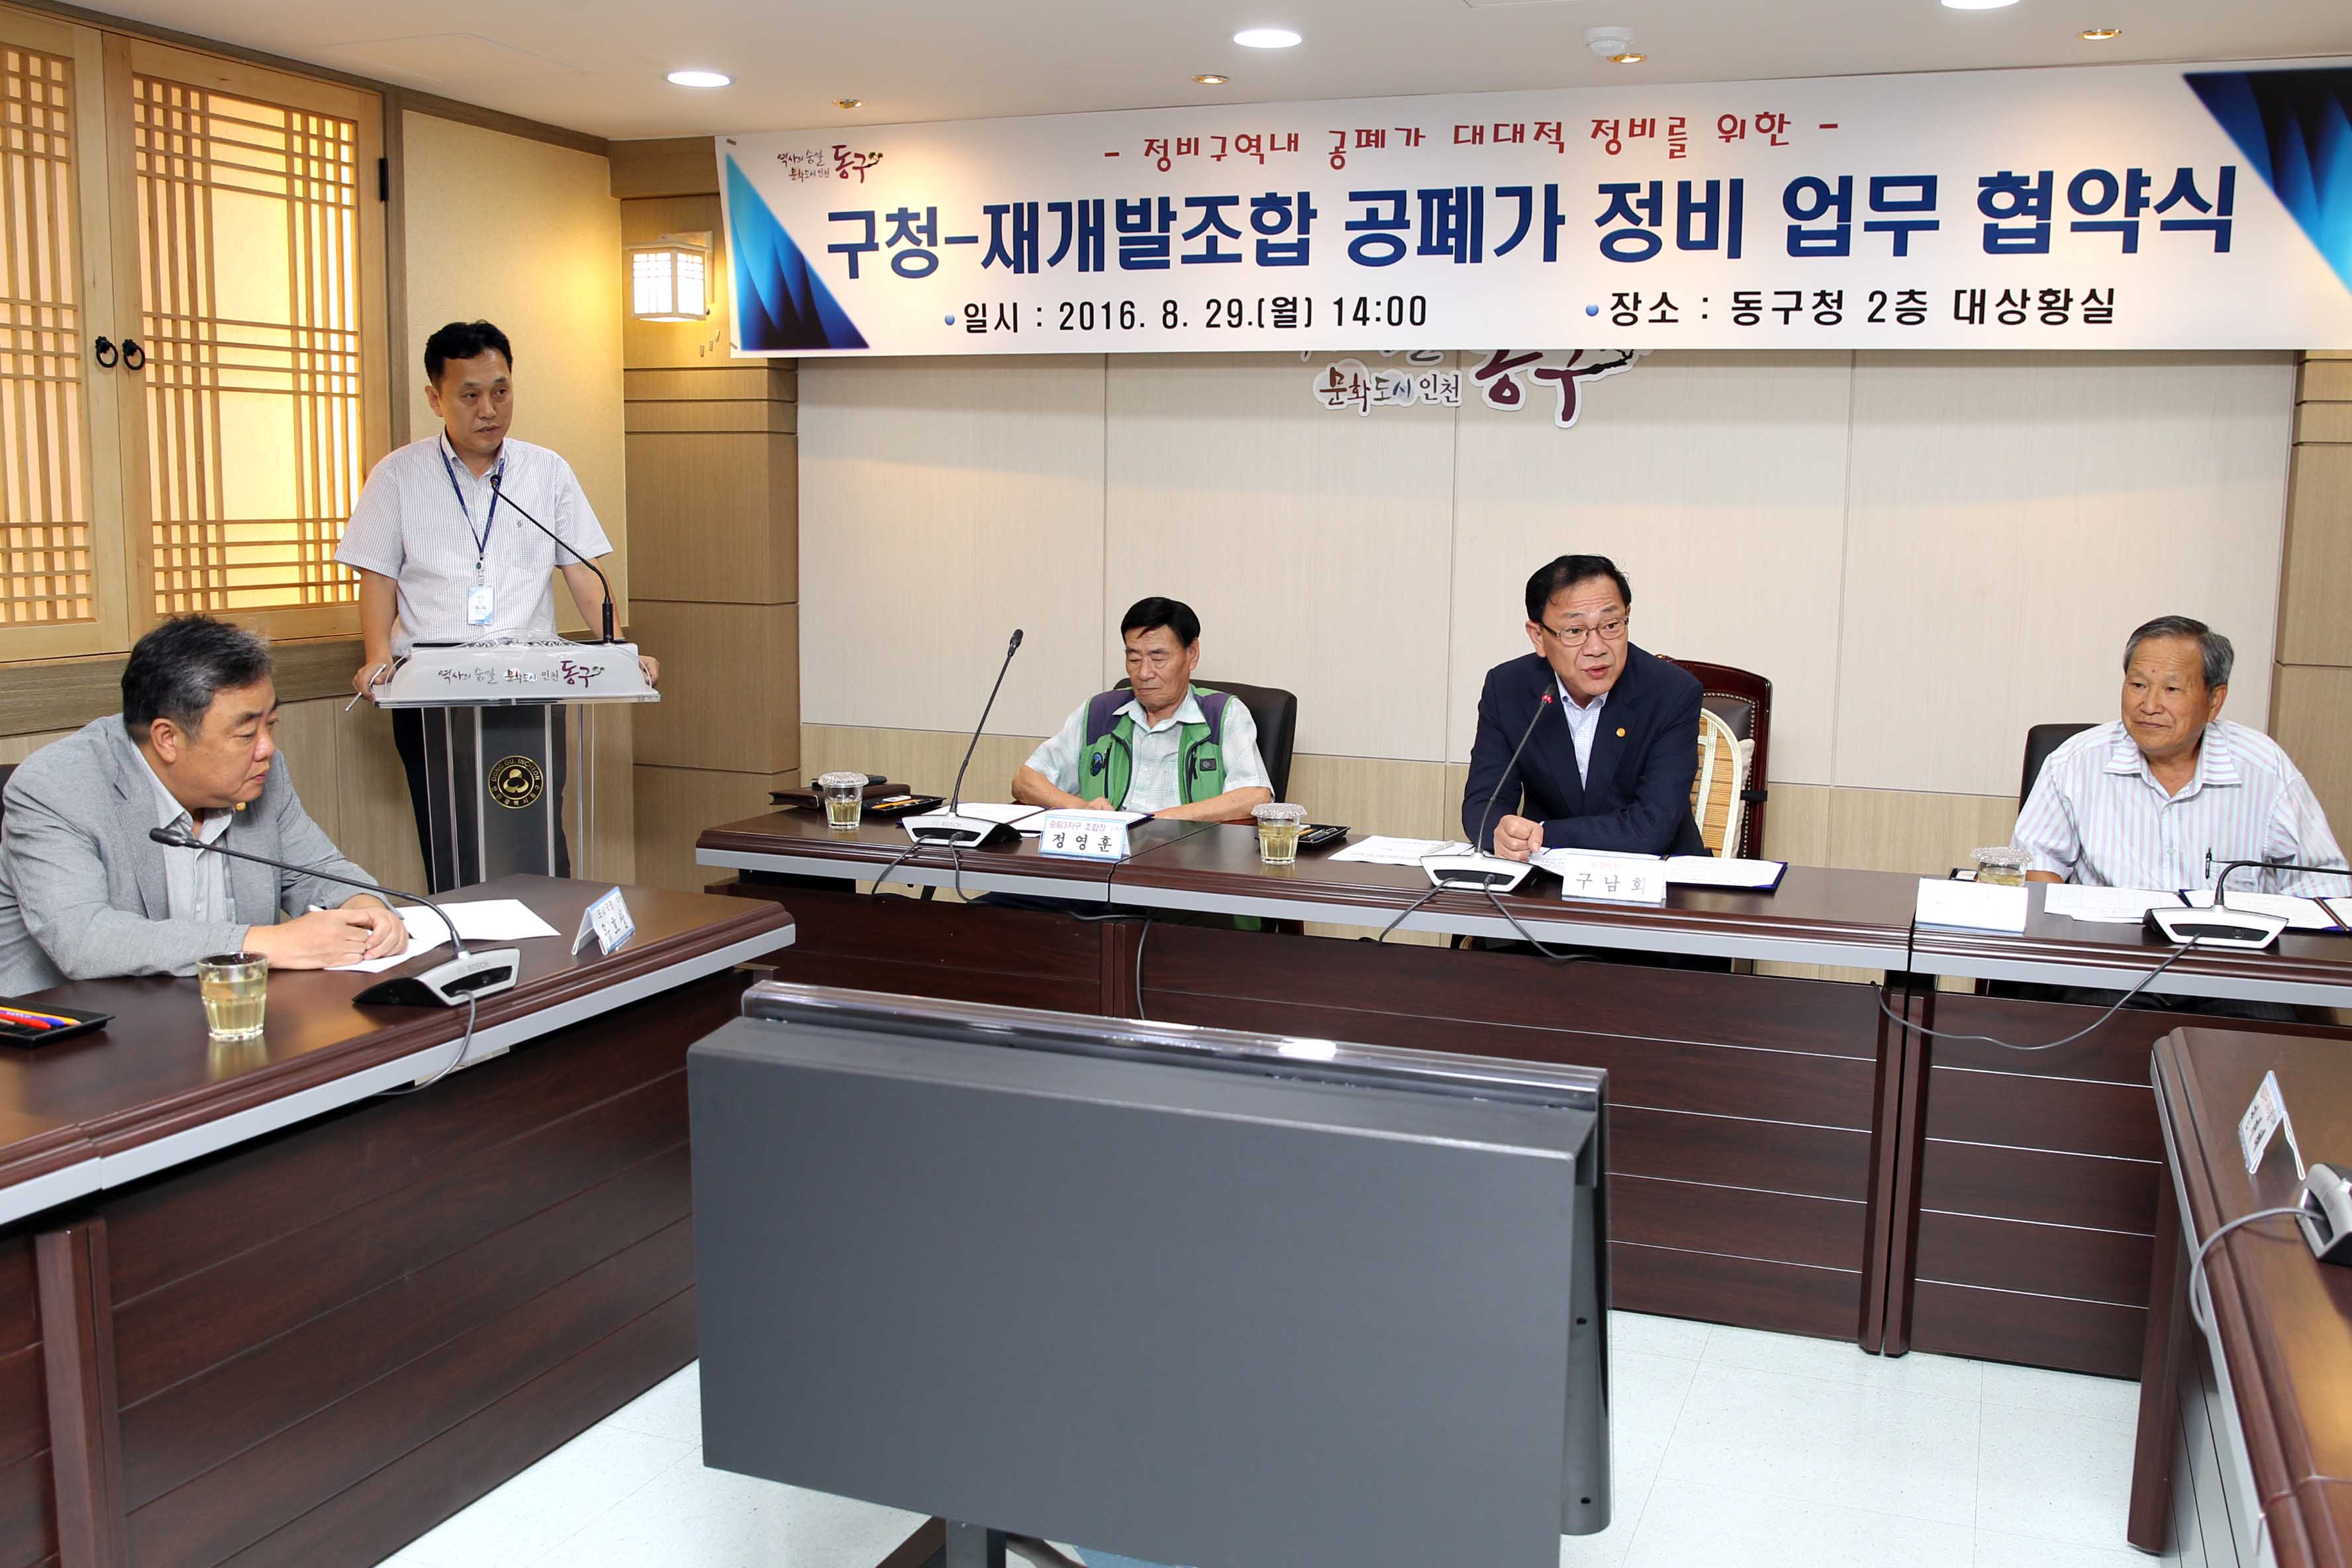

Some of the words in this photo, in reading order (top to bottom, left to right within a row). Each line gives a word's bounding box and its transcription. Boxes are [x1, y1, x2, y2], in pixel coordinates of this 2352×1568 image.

[1144, 134, 1299, 172] 정비구역내
[1328, 127, 1426, 170] 공폐가
[1453, 121, 1565, 154] 대대적
[1591, 116, 1688, 160] 정비를
[1716, 111, 1791, 146] 위한
[832, 144, 869, 183] 동구
[1345, 183, 1565, 268] 공폐가
[1594, 178, 1744, 263] 정비
[1783, 175, 1939, 258] 업무
[1977, 166, 2236, 254] 협약식
[964, 302, 1018, 334] 일시
[1059, 300, 1146, 330] 2016.
[1162, 299, 1187, 329] 8.
[1206, 295, 1312, 328] 29.(월)
[1333, 295, 1426, 326] 14:00
[1610, 292, 1679, 326] 장소
[1732, 289, 1843, 326] 동구청
[1867, 289, 1928, 326] 2층
[1953, 287, 2115, 326] 대상황실
[1319, 366, 1411, 413] 문화도시
[1419, 372, 1459, 403] 인천
[438, 669, 471, 683] 역사의
[542, 669, 559, 681] 인천
[560, 661, 593, 688] 동구
[491, 764, 505, 782] DONG
[518, 759, 541, 780] INCHEON
